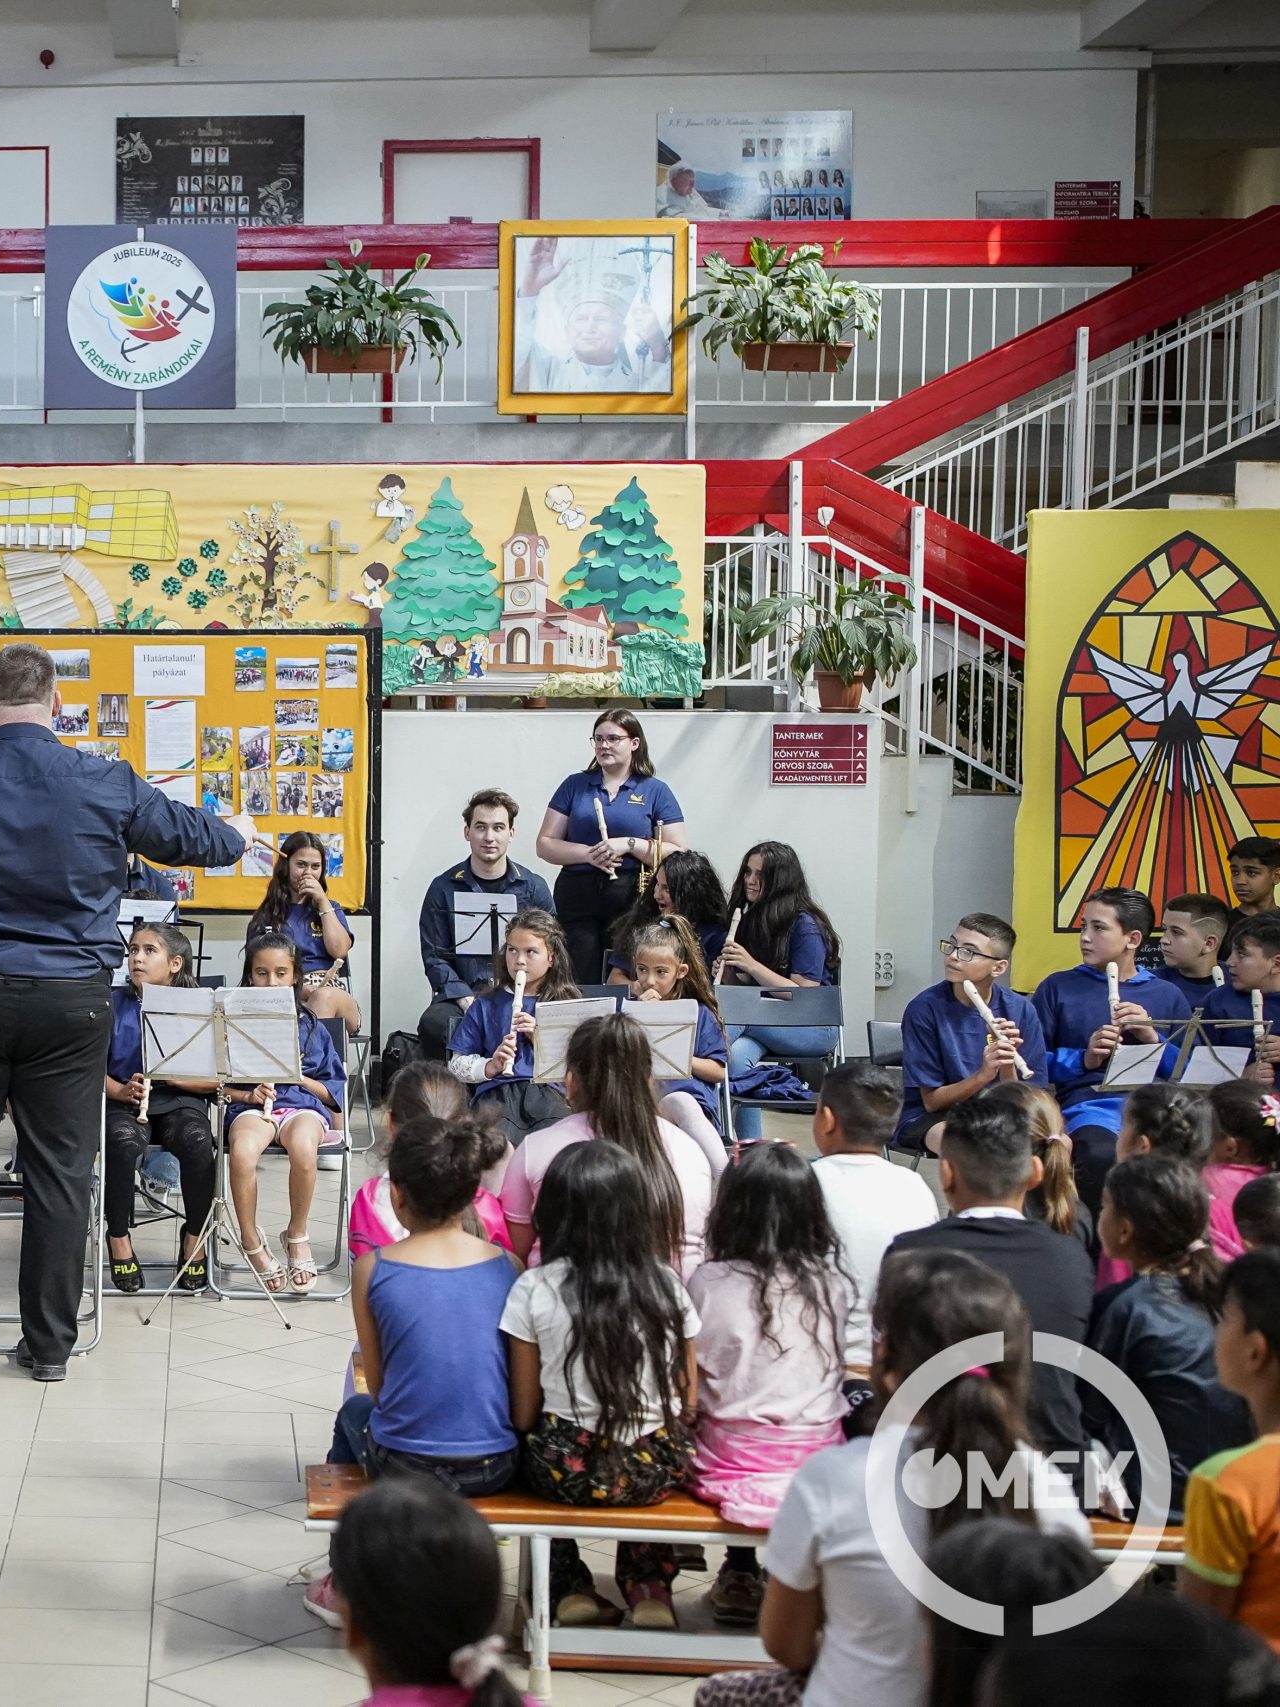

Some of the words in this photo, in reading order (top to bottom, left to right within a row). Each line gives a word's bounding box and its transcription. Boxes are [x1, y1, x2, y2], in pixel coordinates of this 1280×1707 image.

[113, 247, 160, 263] JUBILEUM
[160, 251, 183, 268] 2025
[79, 339, 90, 350] A
[85, 349, 131, 382] REMÉNY
[133, 338, 203, 384] ZARÁNDOKAI
[143, 653, 196, 663] Határtalanul!
[152, 667, 187, 678] pályázat
[774, 732, 824, 740] TANTERMEK
[774, 762, 805, 770] ORVOSI
[806, 762, 834, 770] SZOBA
[774, 774, 833, 782] AKADÁLYMENTES
[114, 1262, 138, 1275] FILA
